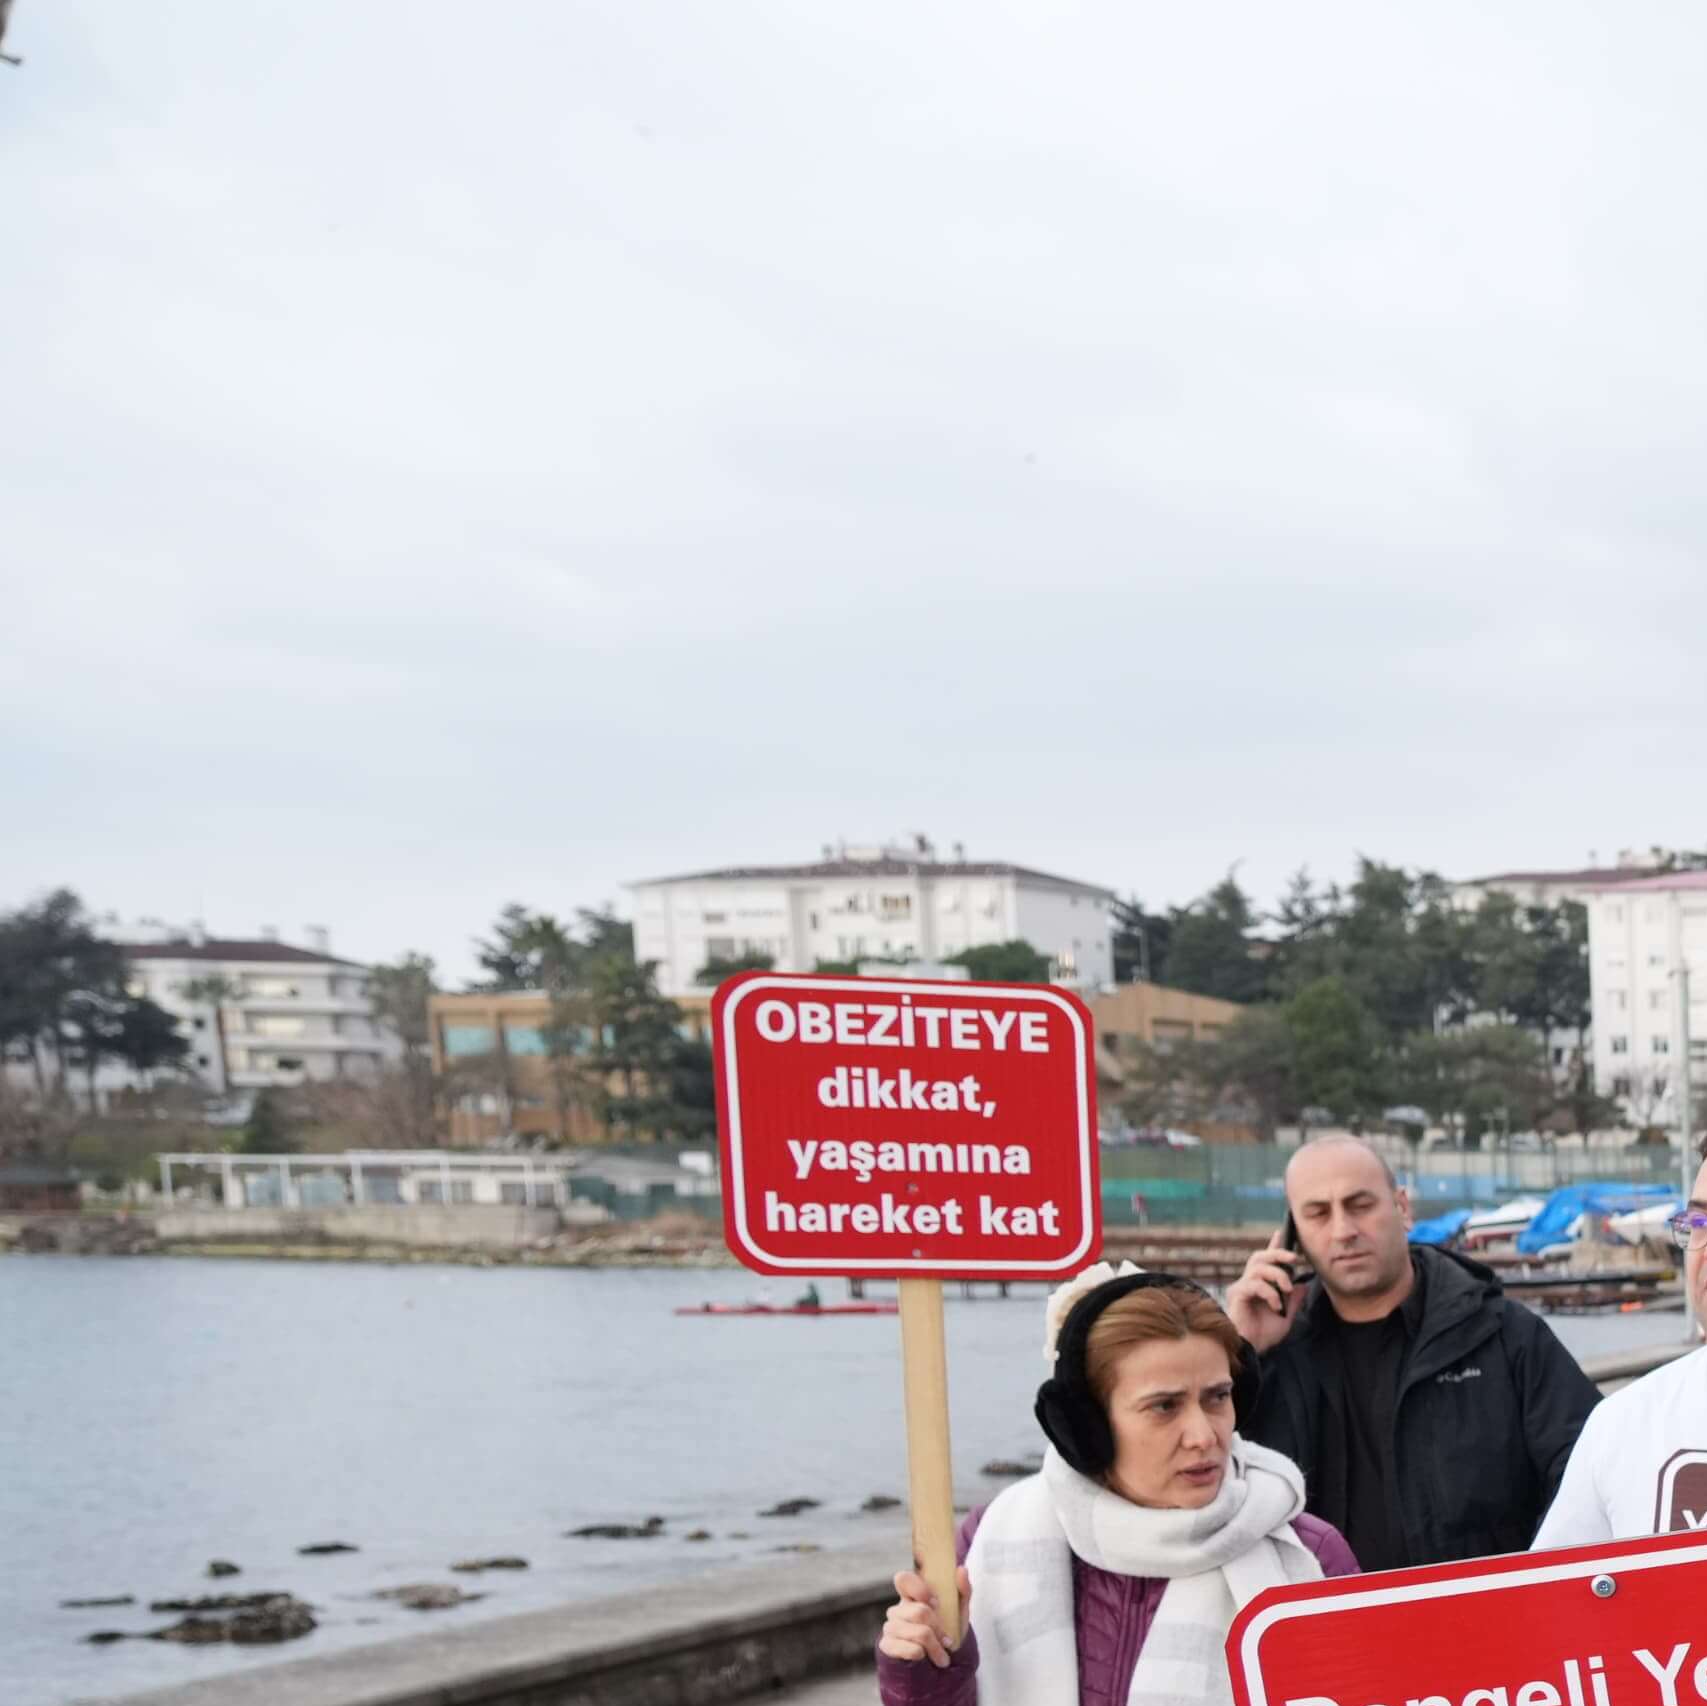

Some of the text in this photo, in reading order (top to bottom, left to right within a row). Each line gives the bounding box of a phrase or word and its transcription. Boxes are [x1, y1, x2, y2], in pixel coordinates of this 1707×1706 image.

[755, 994, 1050, 1053] OBEZİTEYE
[817, 1067, 997, 1118] dikkat,
[787, 1138, 1031, 1183] yaşamına
[765, 1191, 1060, 1236] hareket kat
